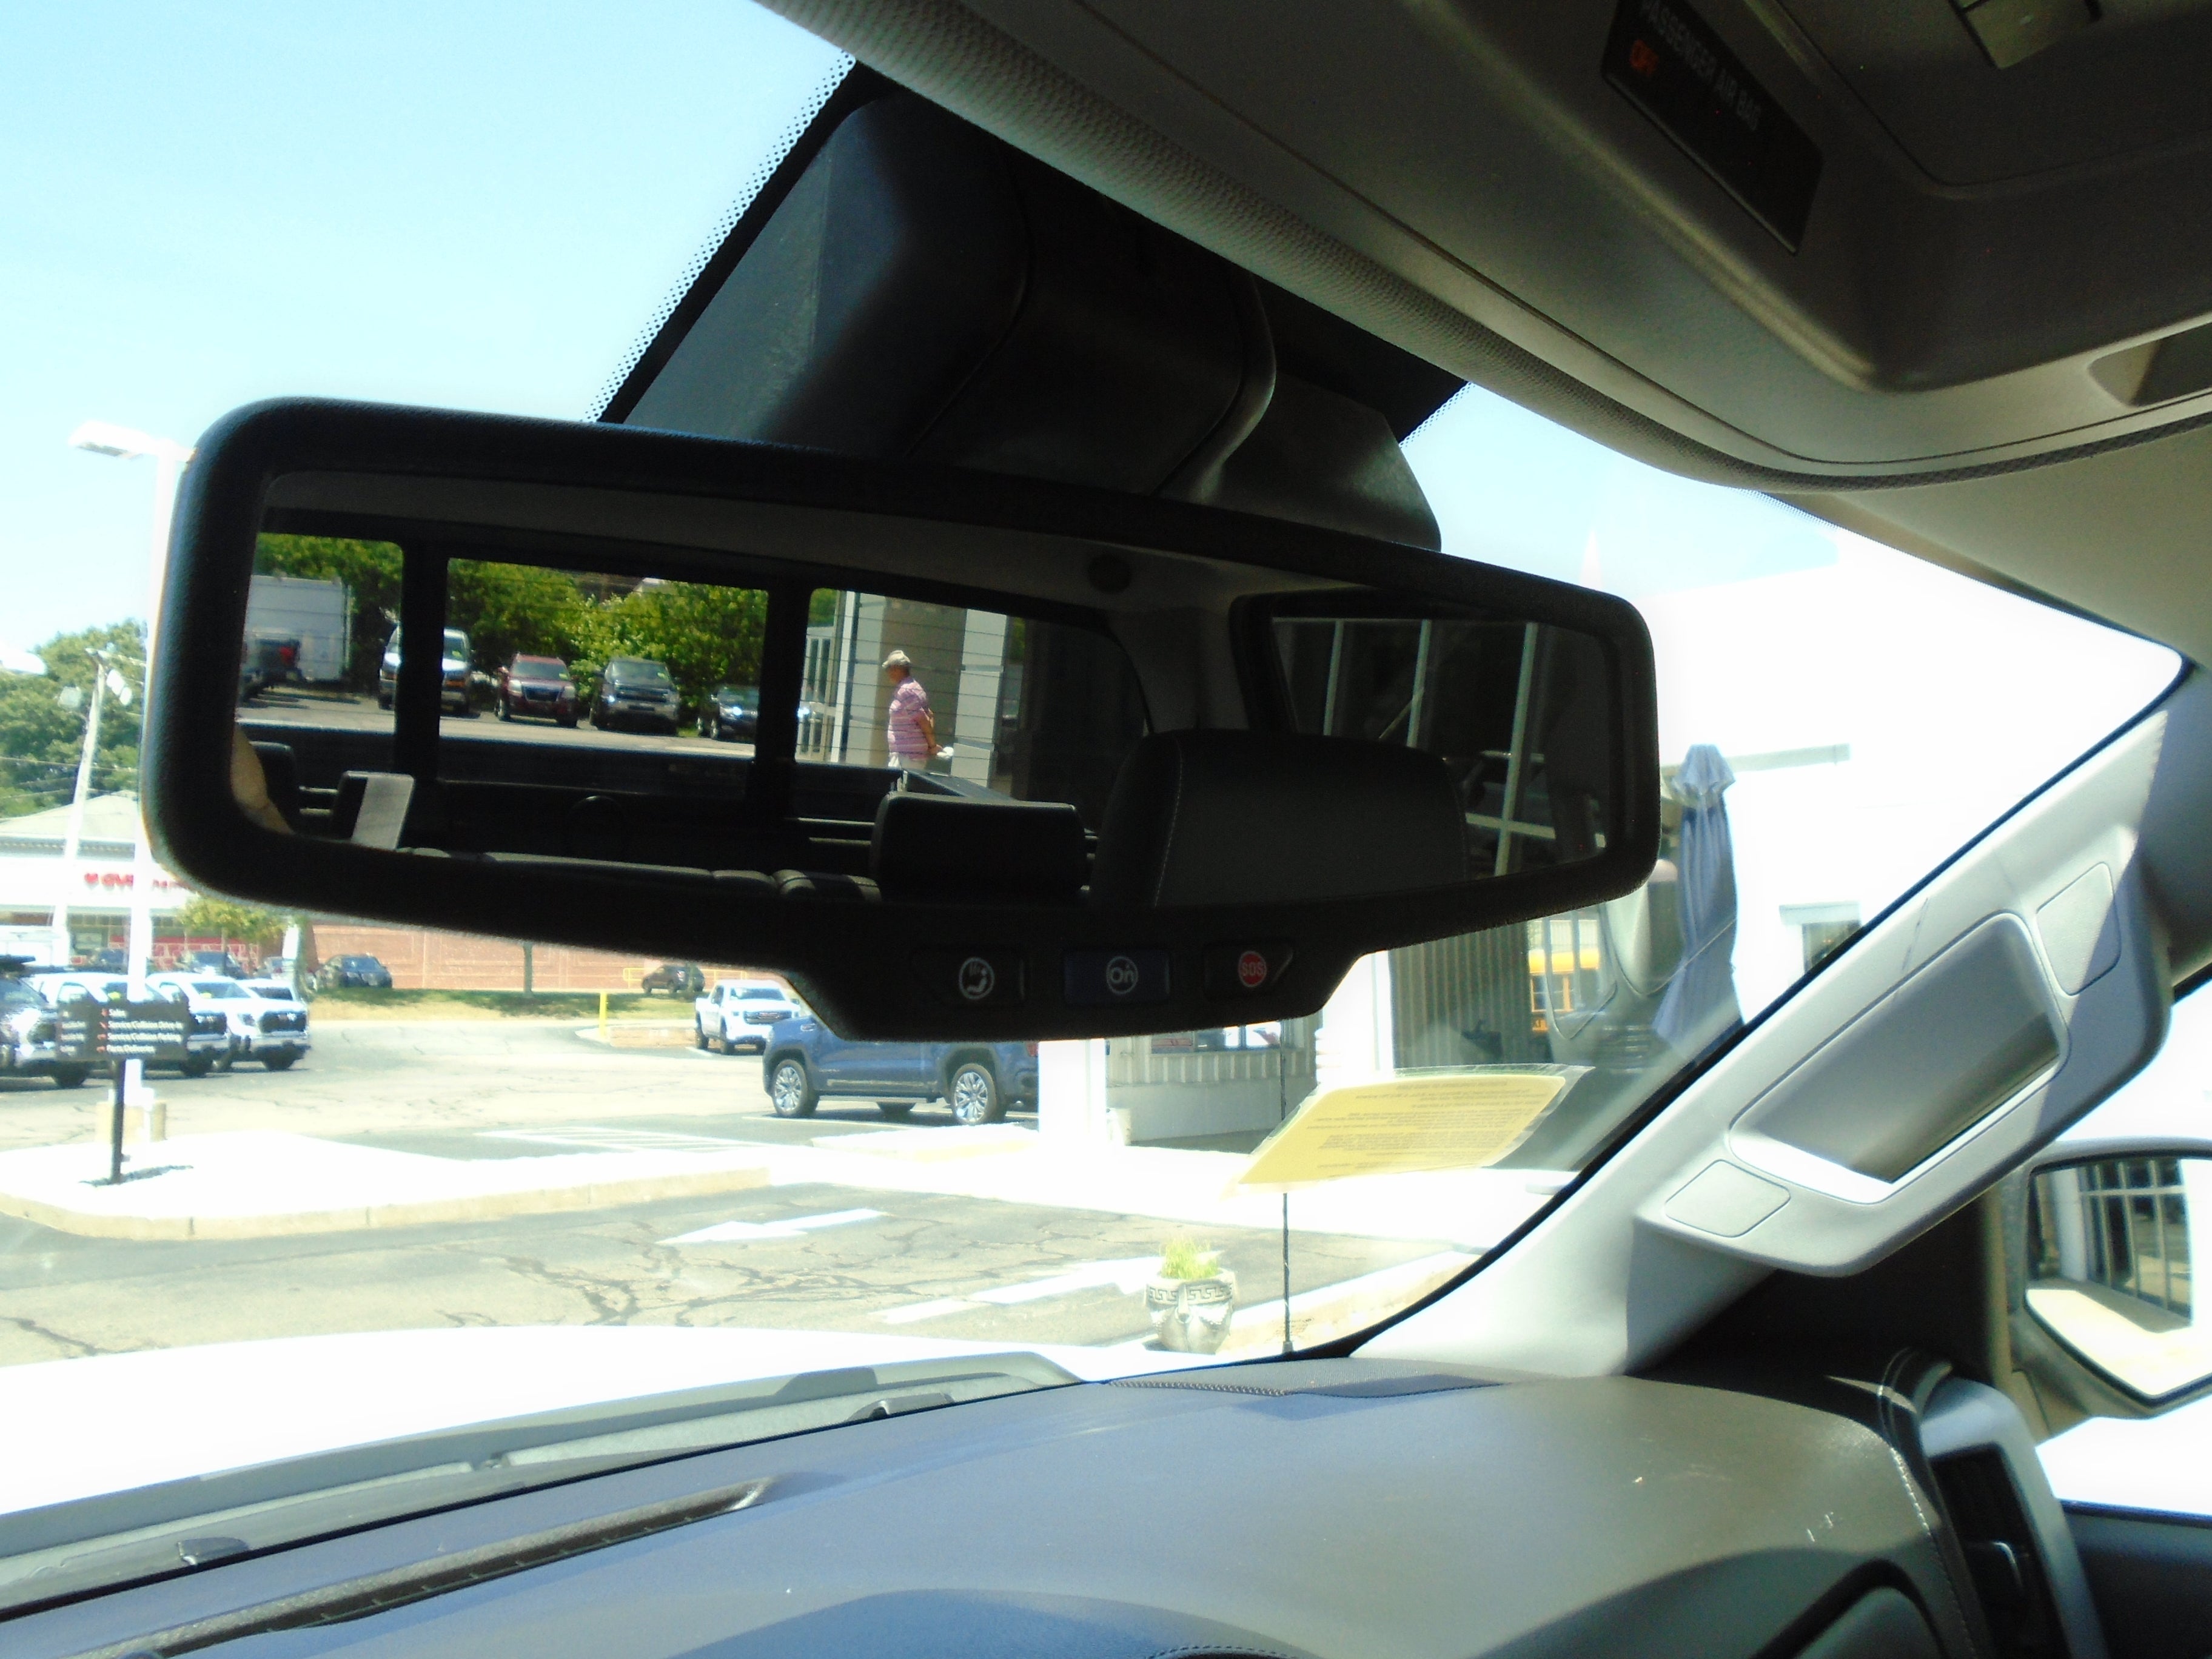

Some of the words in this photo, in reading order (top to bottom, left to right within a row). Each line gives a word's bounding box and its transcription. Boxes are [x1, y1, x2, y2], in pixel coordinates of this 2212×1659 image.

[1713, 67, 1738, 107] AIR
[1736, 89, 1761, 131] BAG
[1241, 961, 1265, 977] SOS
